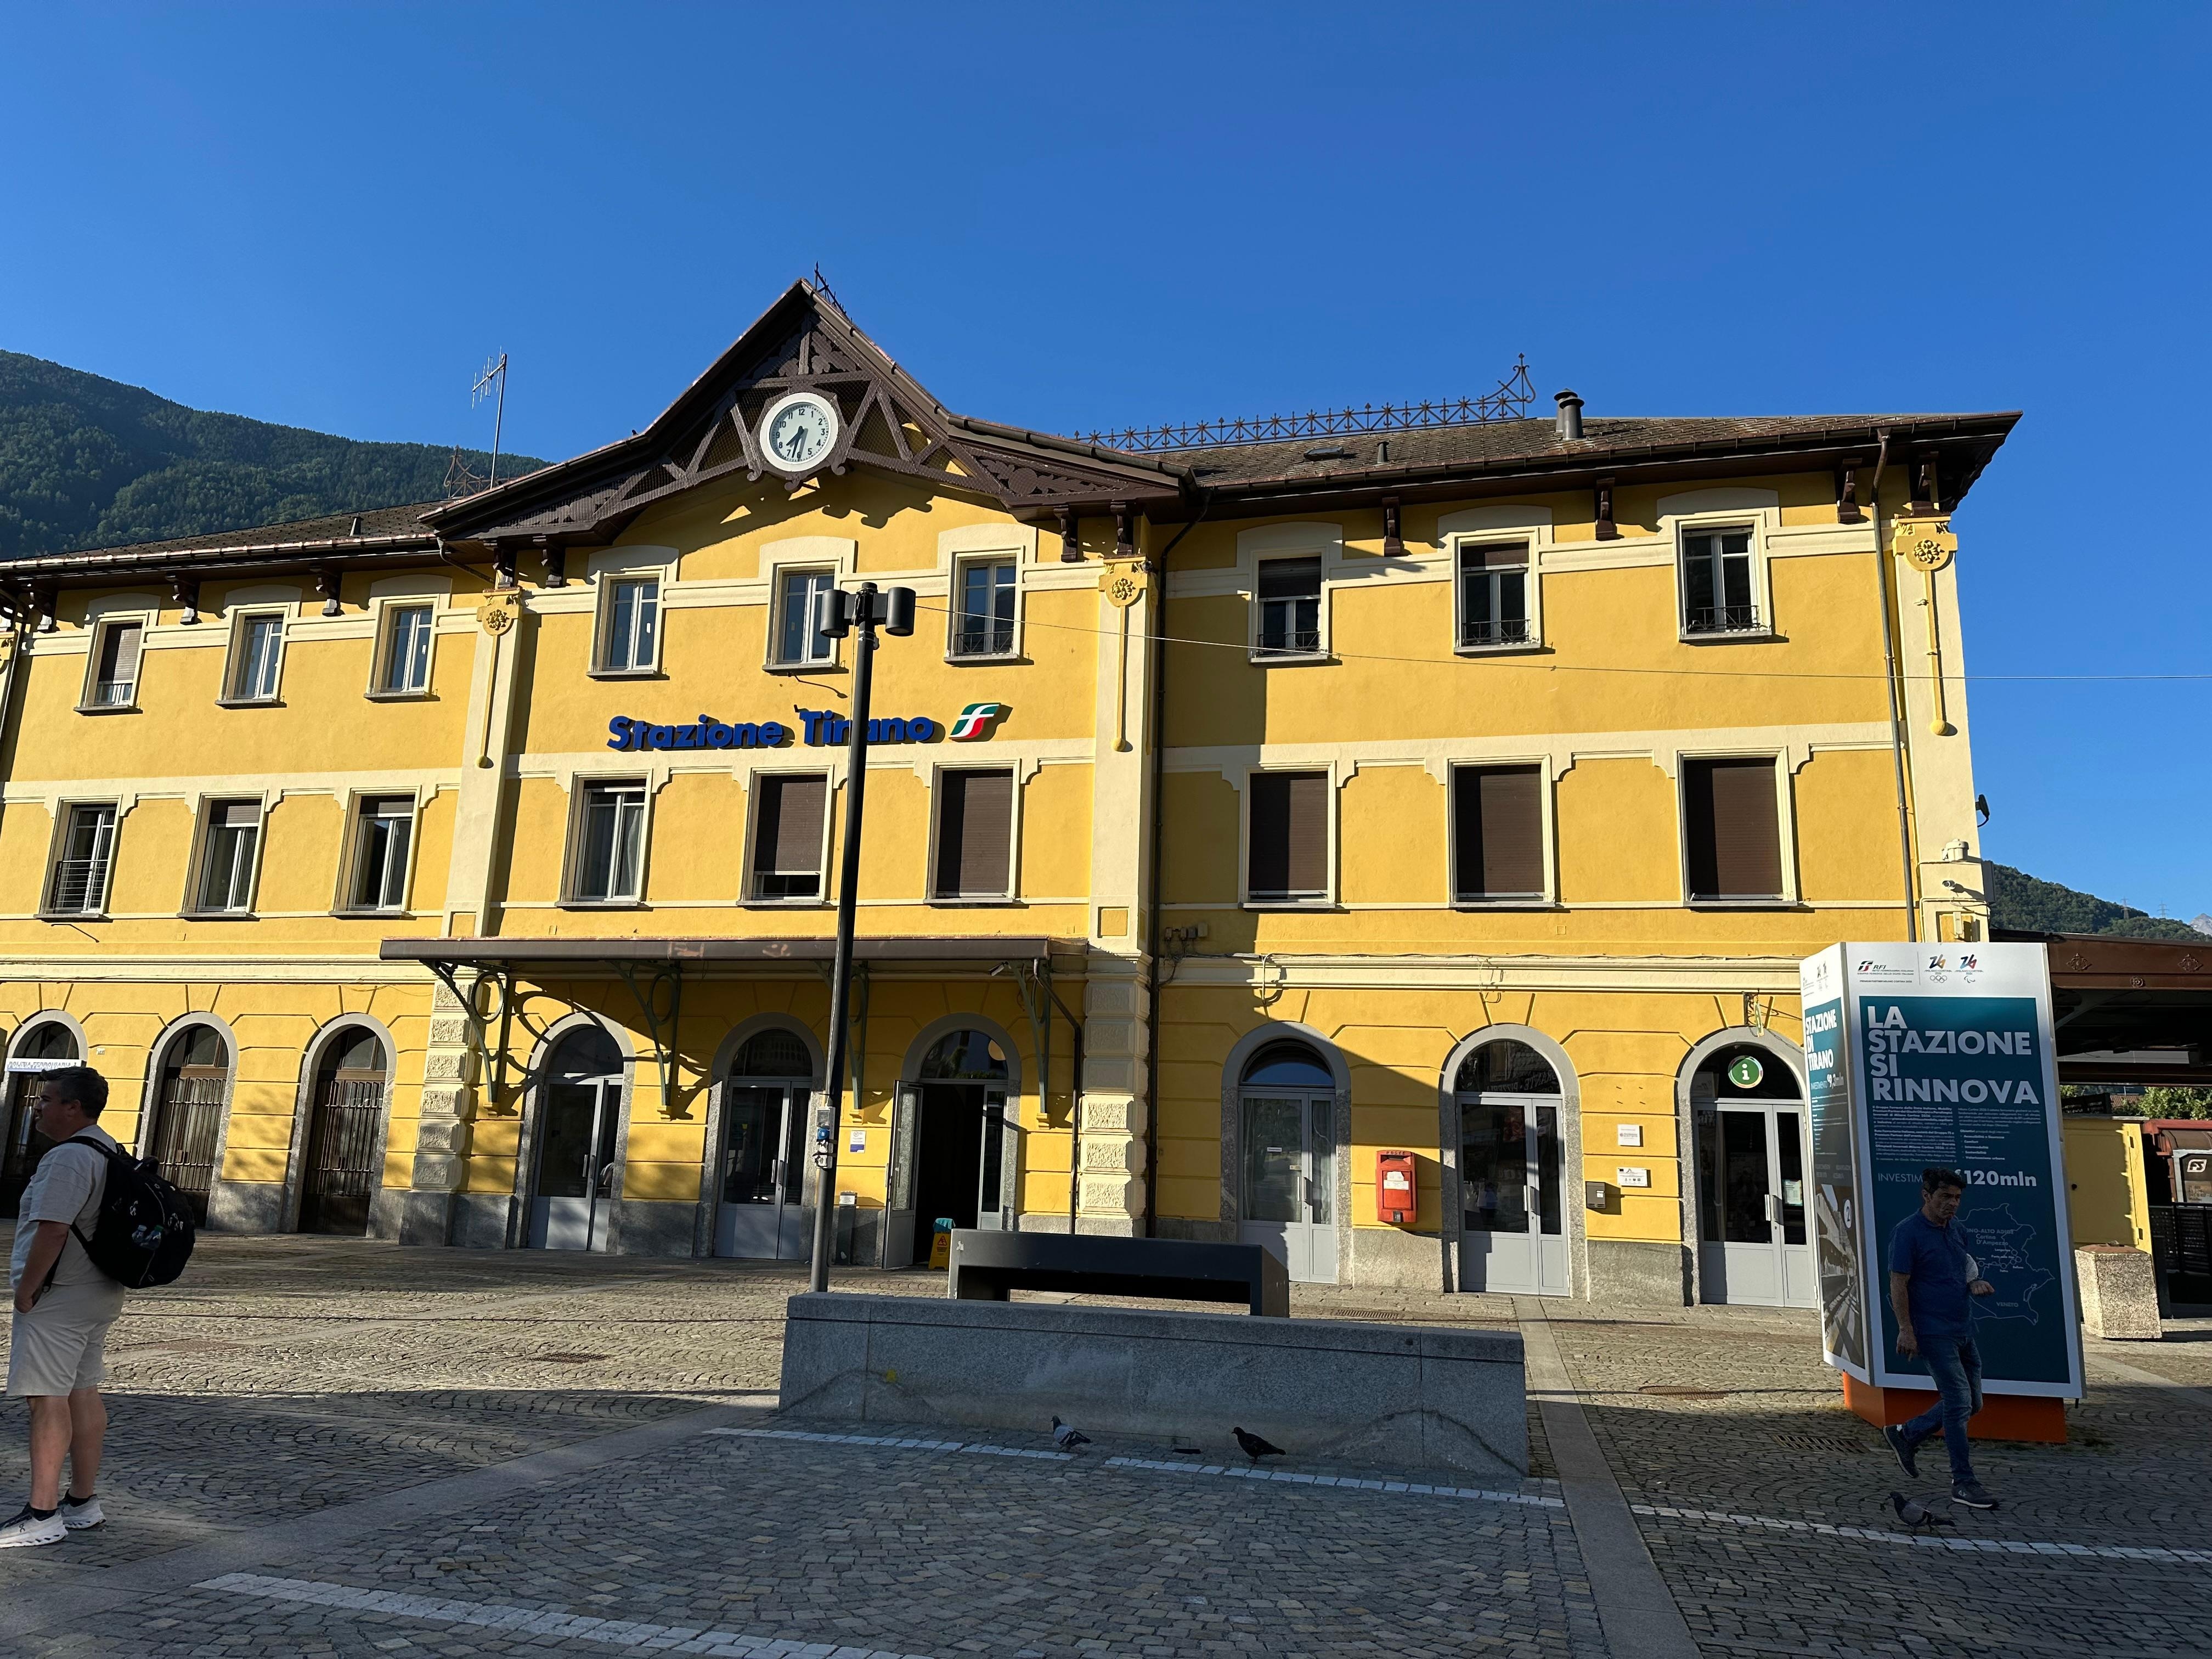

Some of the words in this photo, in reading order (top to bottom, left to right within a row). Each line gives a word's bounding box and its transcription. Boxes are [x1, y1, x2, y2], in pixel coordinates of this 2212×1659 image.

[787, 449, 791, 457] 7
[606, 713, 783, 749] Stazione
[1806, 1008, 1837, 1035] STAZIONE
[1867, 1006, 1908, 1029] LA
[1807, 1035, 1814, 1053] DI
[1868, 1029, 2032, 1054] STAZIONE
[1808, 1048, 1834, 1071] TIRANO
[1870, 1053, 1898, 1077] SI
[1872, 1077, 2039, 1104] RINNOVA
[1878, 1172, 1923, 1183] INVESTIM
[1846, 1206, 1850, 1222] 2
